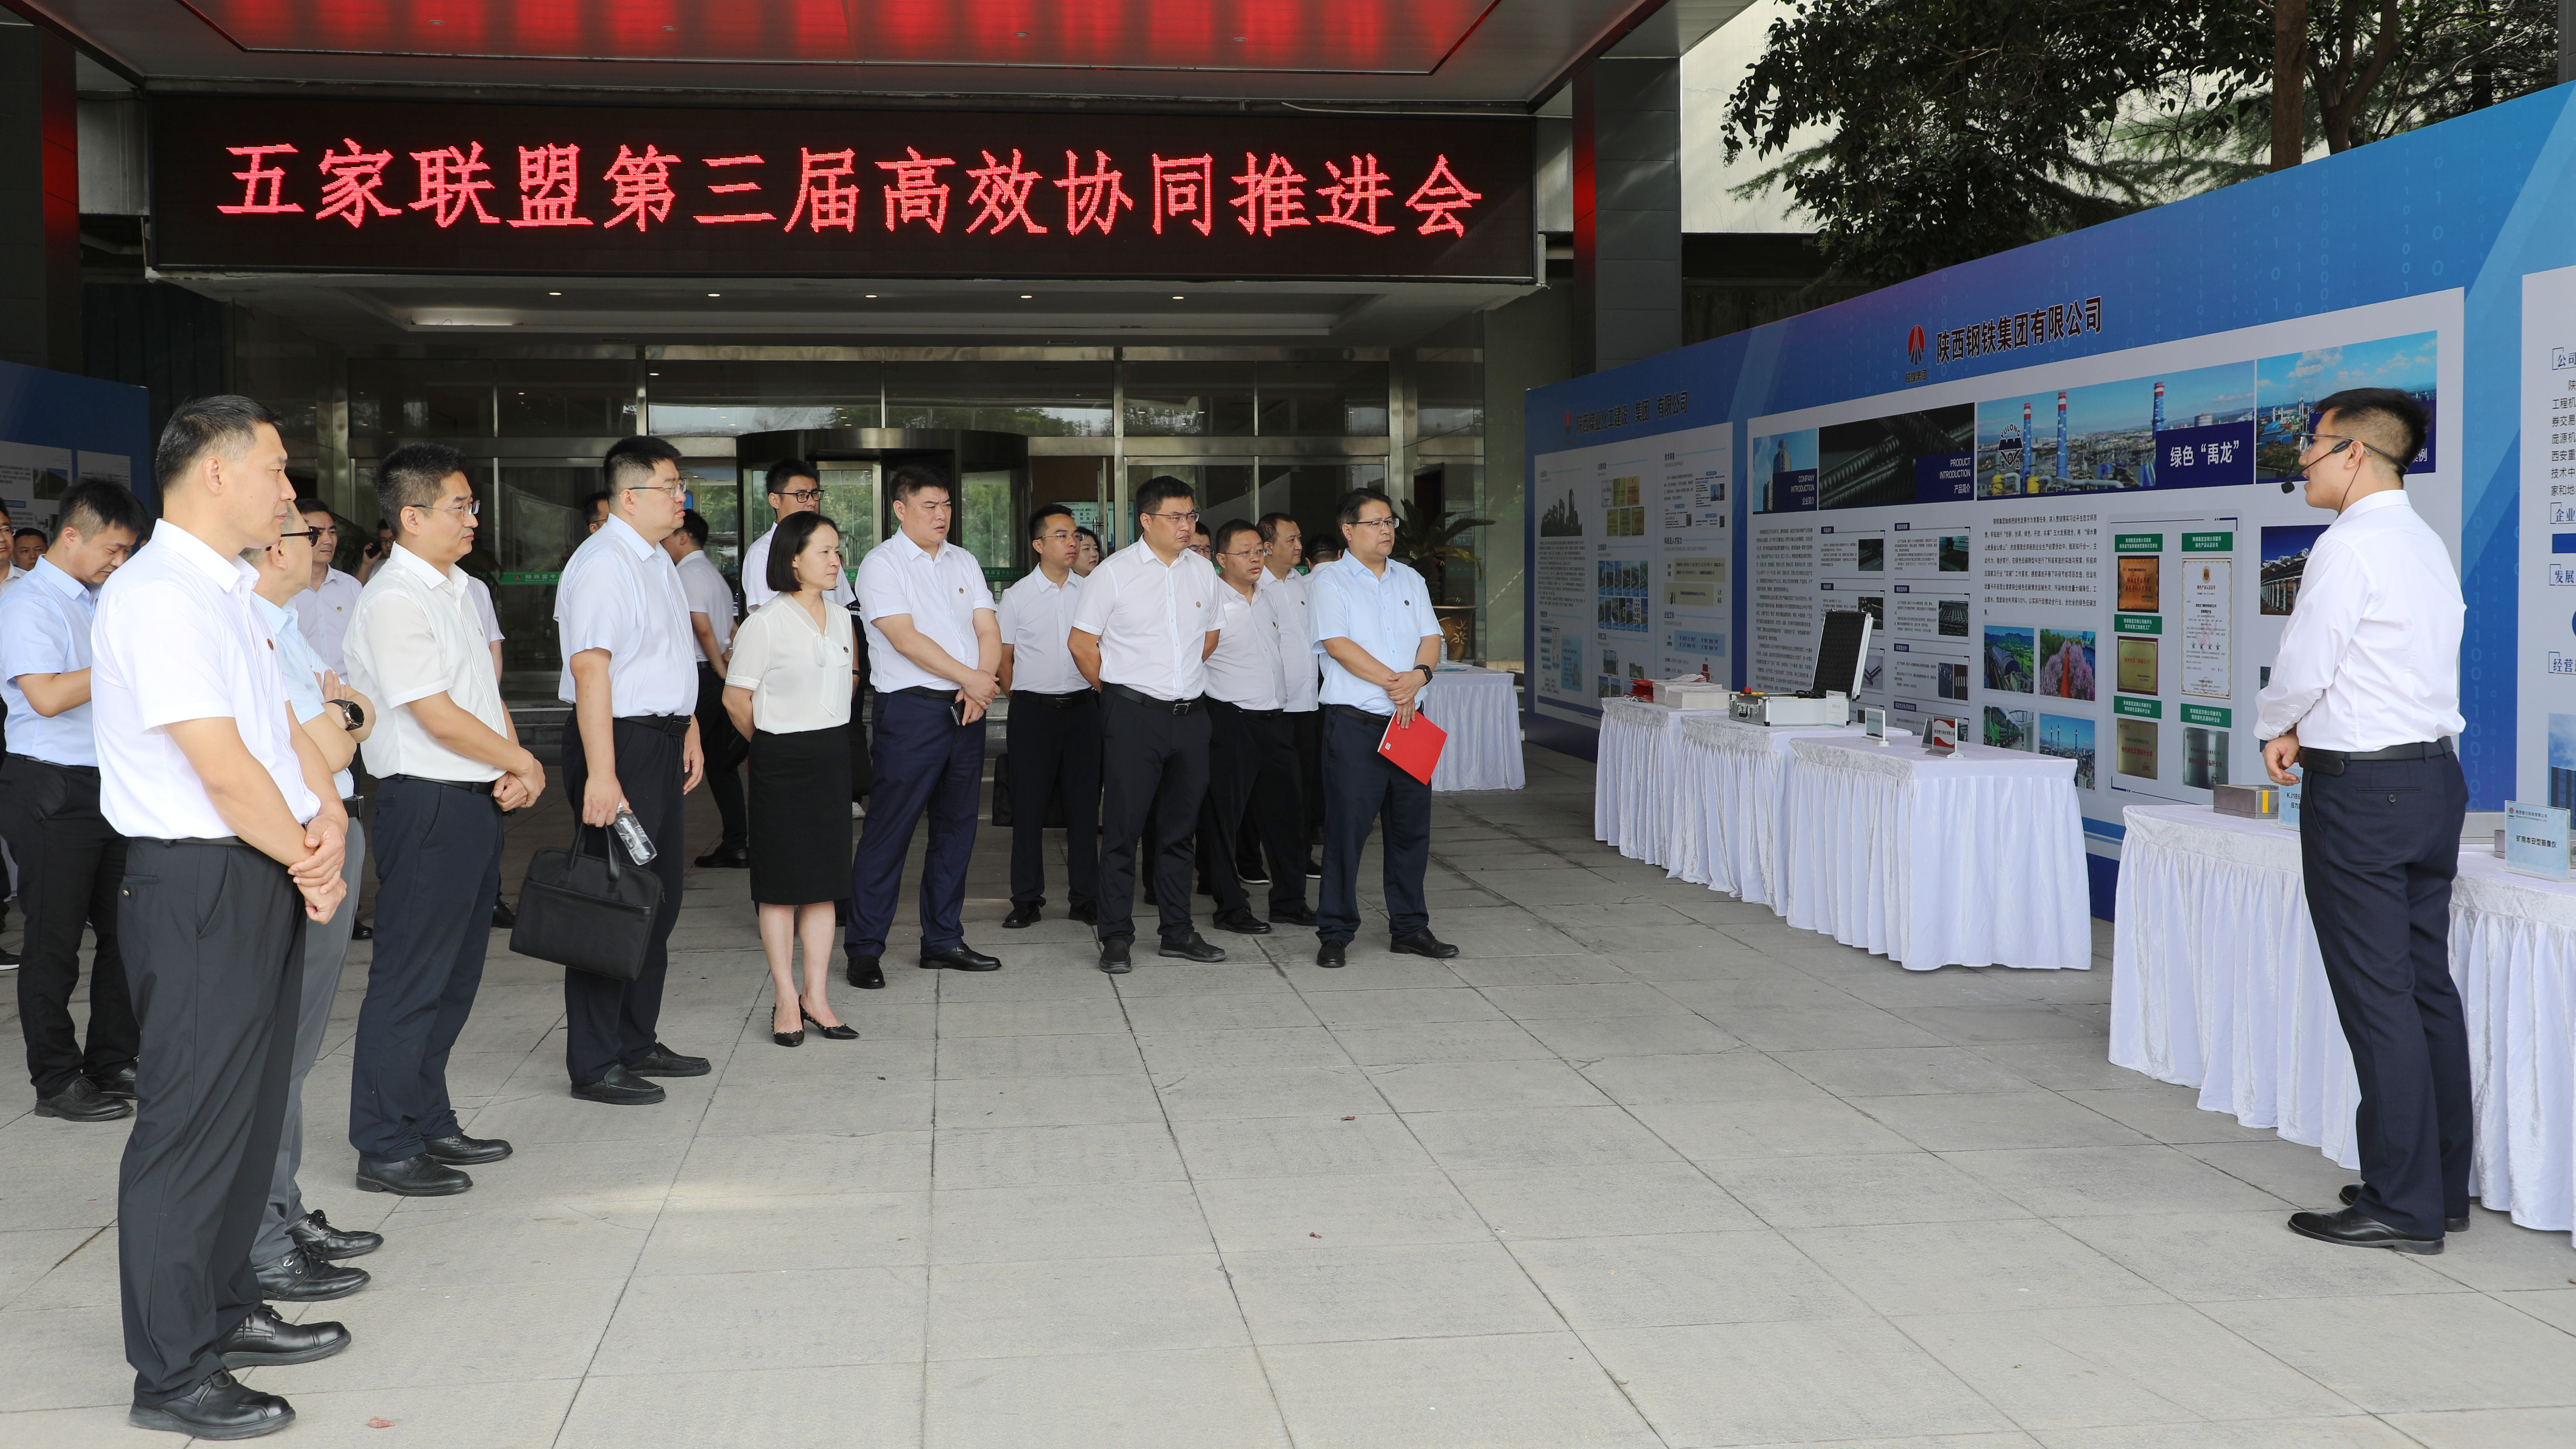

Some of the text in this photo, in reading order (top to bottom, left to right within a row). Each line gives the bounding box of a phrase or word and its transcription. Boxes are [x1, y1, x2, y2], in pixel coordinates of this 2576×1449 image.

[217, 138, 1481, 237] 五家联盟第三届高效协同推进会
[1936, 296, 2102, 365] 陕西钢铁集团有限公司
[2557, 352, 2576, 367] 公司
[2552, 397, 2576, 409] 工程机
[2000, 423, 2021, 438] YULONG
[2413, 448, 2427, 462] 例
[2551, 449, 2576, 462] 西安重
[1950, 457, 1971, 467] PRODUCT
[1798, 474, 1815, 482] COMPANY
[1940, 469, 1971, 479] INTRODUCTION
[2551, 467, 2576, 479] 技术中
[1791, 484, 1815, 493] INTRODUCTION
[1954, 484, 1971, 494] 产品简介
[1802, 496, 1815, 505] 企业简介
[2555, 508, 2575, 522] 企业
[2555, 570, 2576, 584] 发展
[2553, 659, 2576, 673] 经营
[2516, 835, 2557, 848] 矿用本安型摄像仪
